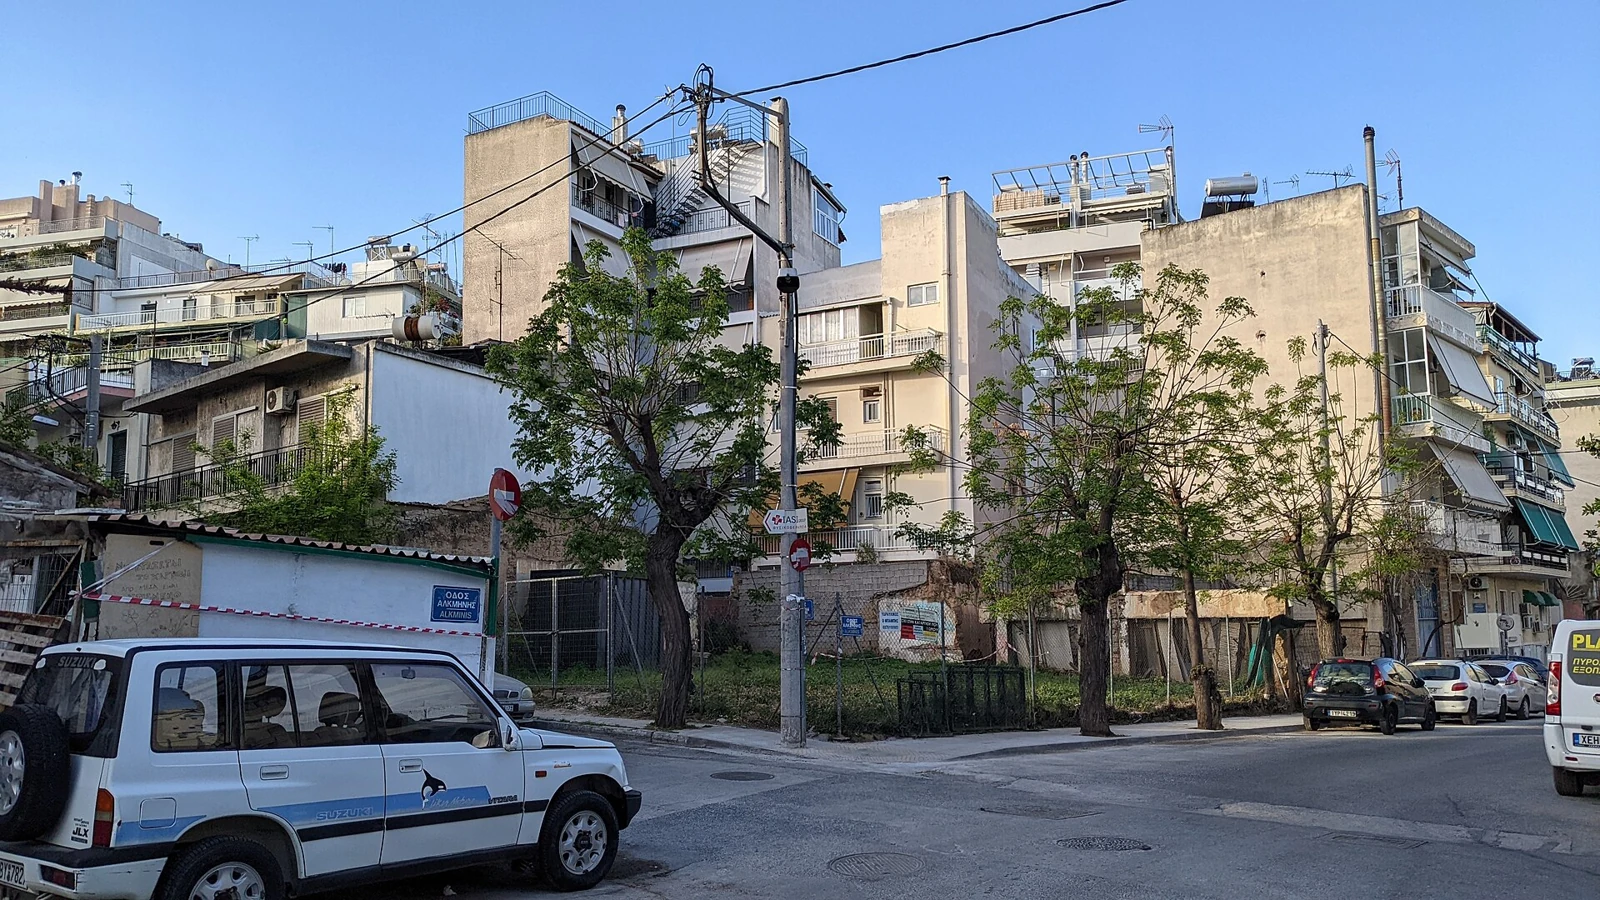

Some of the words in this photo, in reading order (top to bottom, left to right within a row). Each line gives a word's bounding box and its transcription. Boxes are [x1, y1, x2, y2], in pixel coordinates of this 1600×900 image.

[446, 591, 469, 600] ΟΔΟΣ
[437, 600, 477, 609] ΑΛΚΜΗΝΗΣ
[440, 611, 472, 619] ALKMINIS
[58, 656, 97, 668] SUZUKI
[1573, 658, 1600, 666] ΠΥΡΟ
[1573, 666, 1600, 674] ΕΞΟΠ
[316, 807, 373, 821] SUZUKI
[72, 827, 90, 838] JLX
